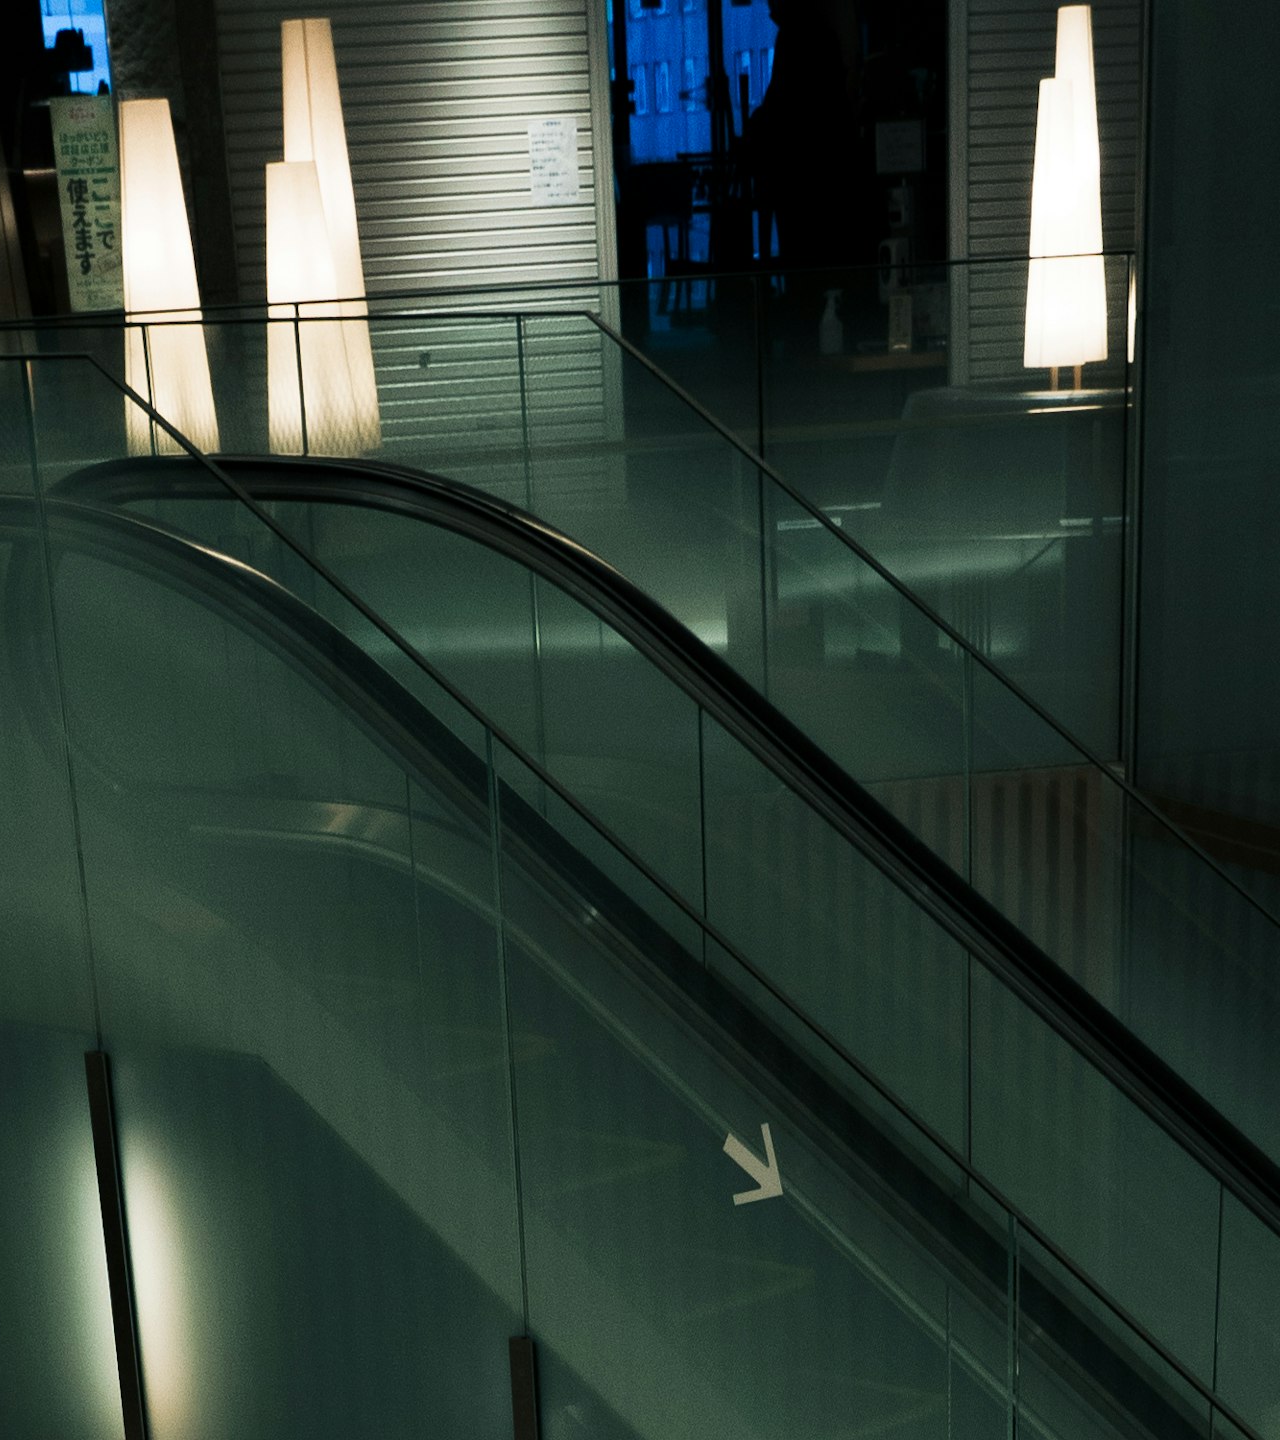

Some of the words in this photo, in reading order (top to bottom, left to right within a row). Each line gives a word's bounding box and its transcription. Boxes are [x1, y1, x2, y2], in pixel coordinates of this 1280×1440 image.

[66, 178, 95, 276] 使えます
[91, 178, 115, 250] ここで
